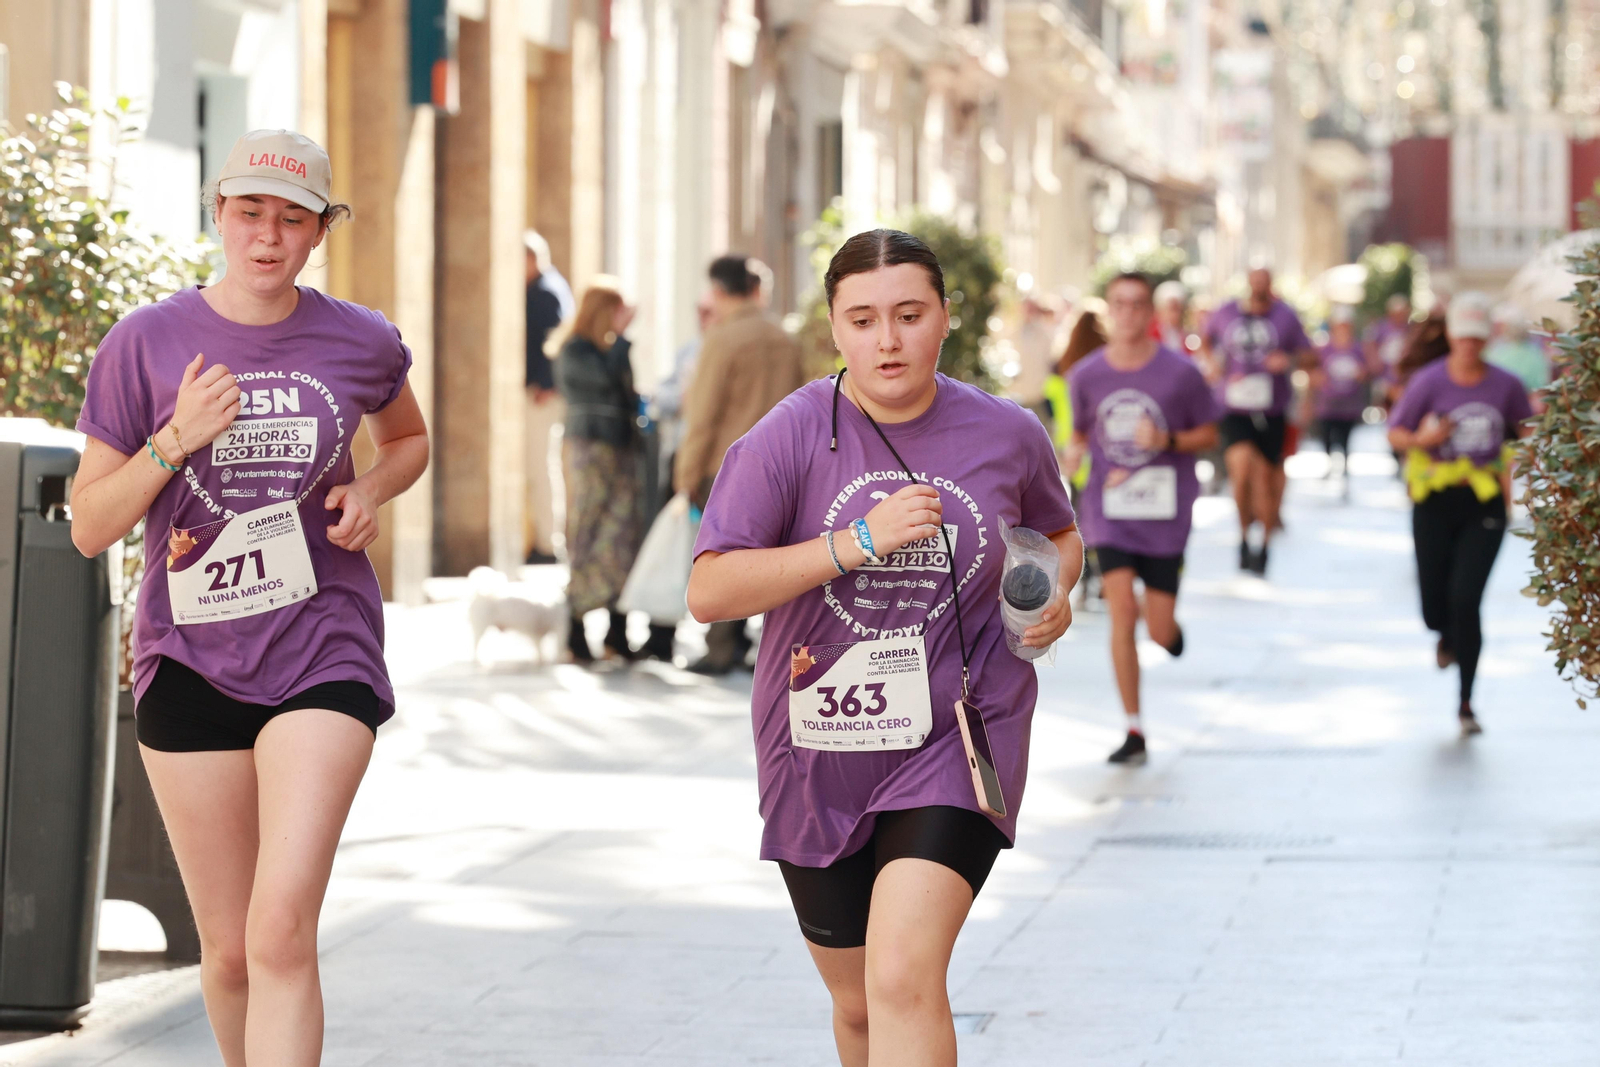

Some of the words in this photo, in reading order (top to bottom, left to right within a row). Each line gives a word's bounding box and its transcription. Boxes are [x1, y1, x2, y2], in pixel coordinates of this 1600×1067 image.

[249, 153, 306, 179] LALIGA
[237, 387, 300, 416] 25N
[290, 371, 340, 416] CONTRA
[335, 417, 345, 439] LA
[262, 420, 314, 430] EMERGENCIAS
[228, 432, 245, 446] 24
[248, 429, 300, 444] HORAS
[217, 447, 249, 462] 900
[251, 445, 266, 458] 21
[269, 444, 285, 457] 21
[288, 444, 309, 458] 30
[234, 469, 277, 480] Ayuntamiento
[278, 469, 286, 478] de
[823, 470, 929, 528] INTERNACIONAL
[932, 476, 983, 525] CONTRA
[247, 510, 293, 530] CARRERA
[977, 526, 988, 549] LA
[890, 553, 907, 567] 21
[907, 552, 923, 566] 21
[925, 552, 946, 566] 30
[204, 548, 266, 592] 271
[197, 593, 211, 606] NI
[212, 590, 240, 604] UNA
[240, 577, 285, 599] MENOS
[852, 621, 879, 640] LAS
[869, 647, 919, 661] CARRERA
[892, 661, 920, 669] VIOLENCIA
[898, 666, 921, 674] MUJERES
[816, 681, 888, 718] 363
[801, 719, 875, 732] TOLERANCIA
[877, 717, 912, 729] CERO
